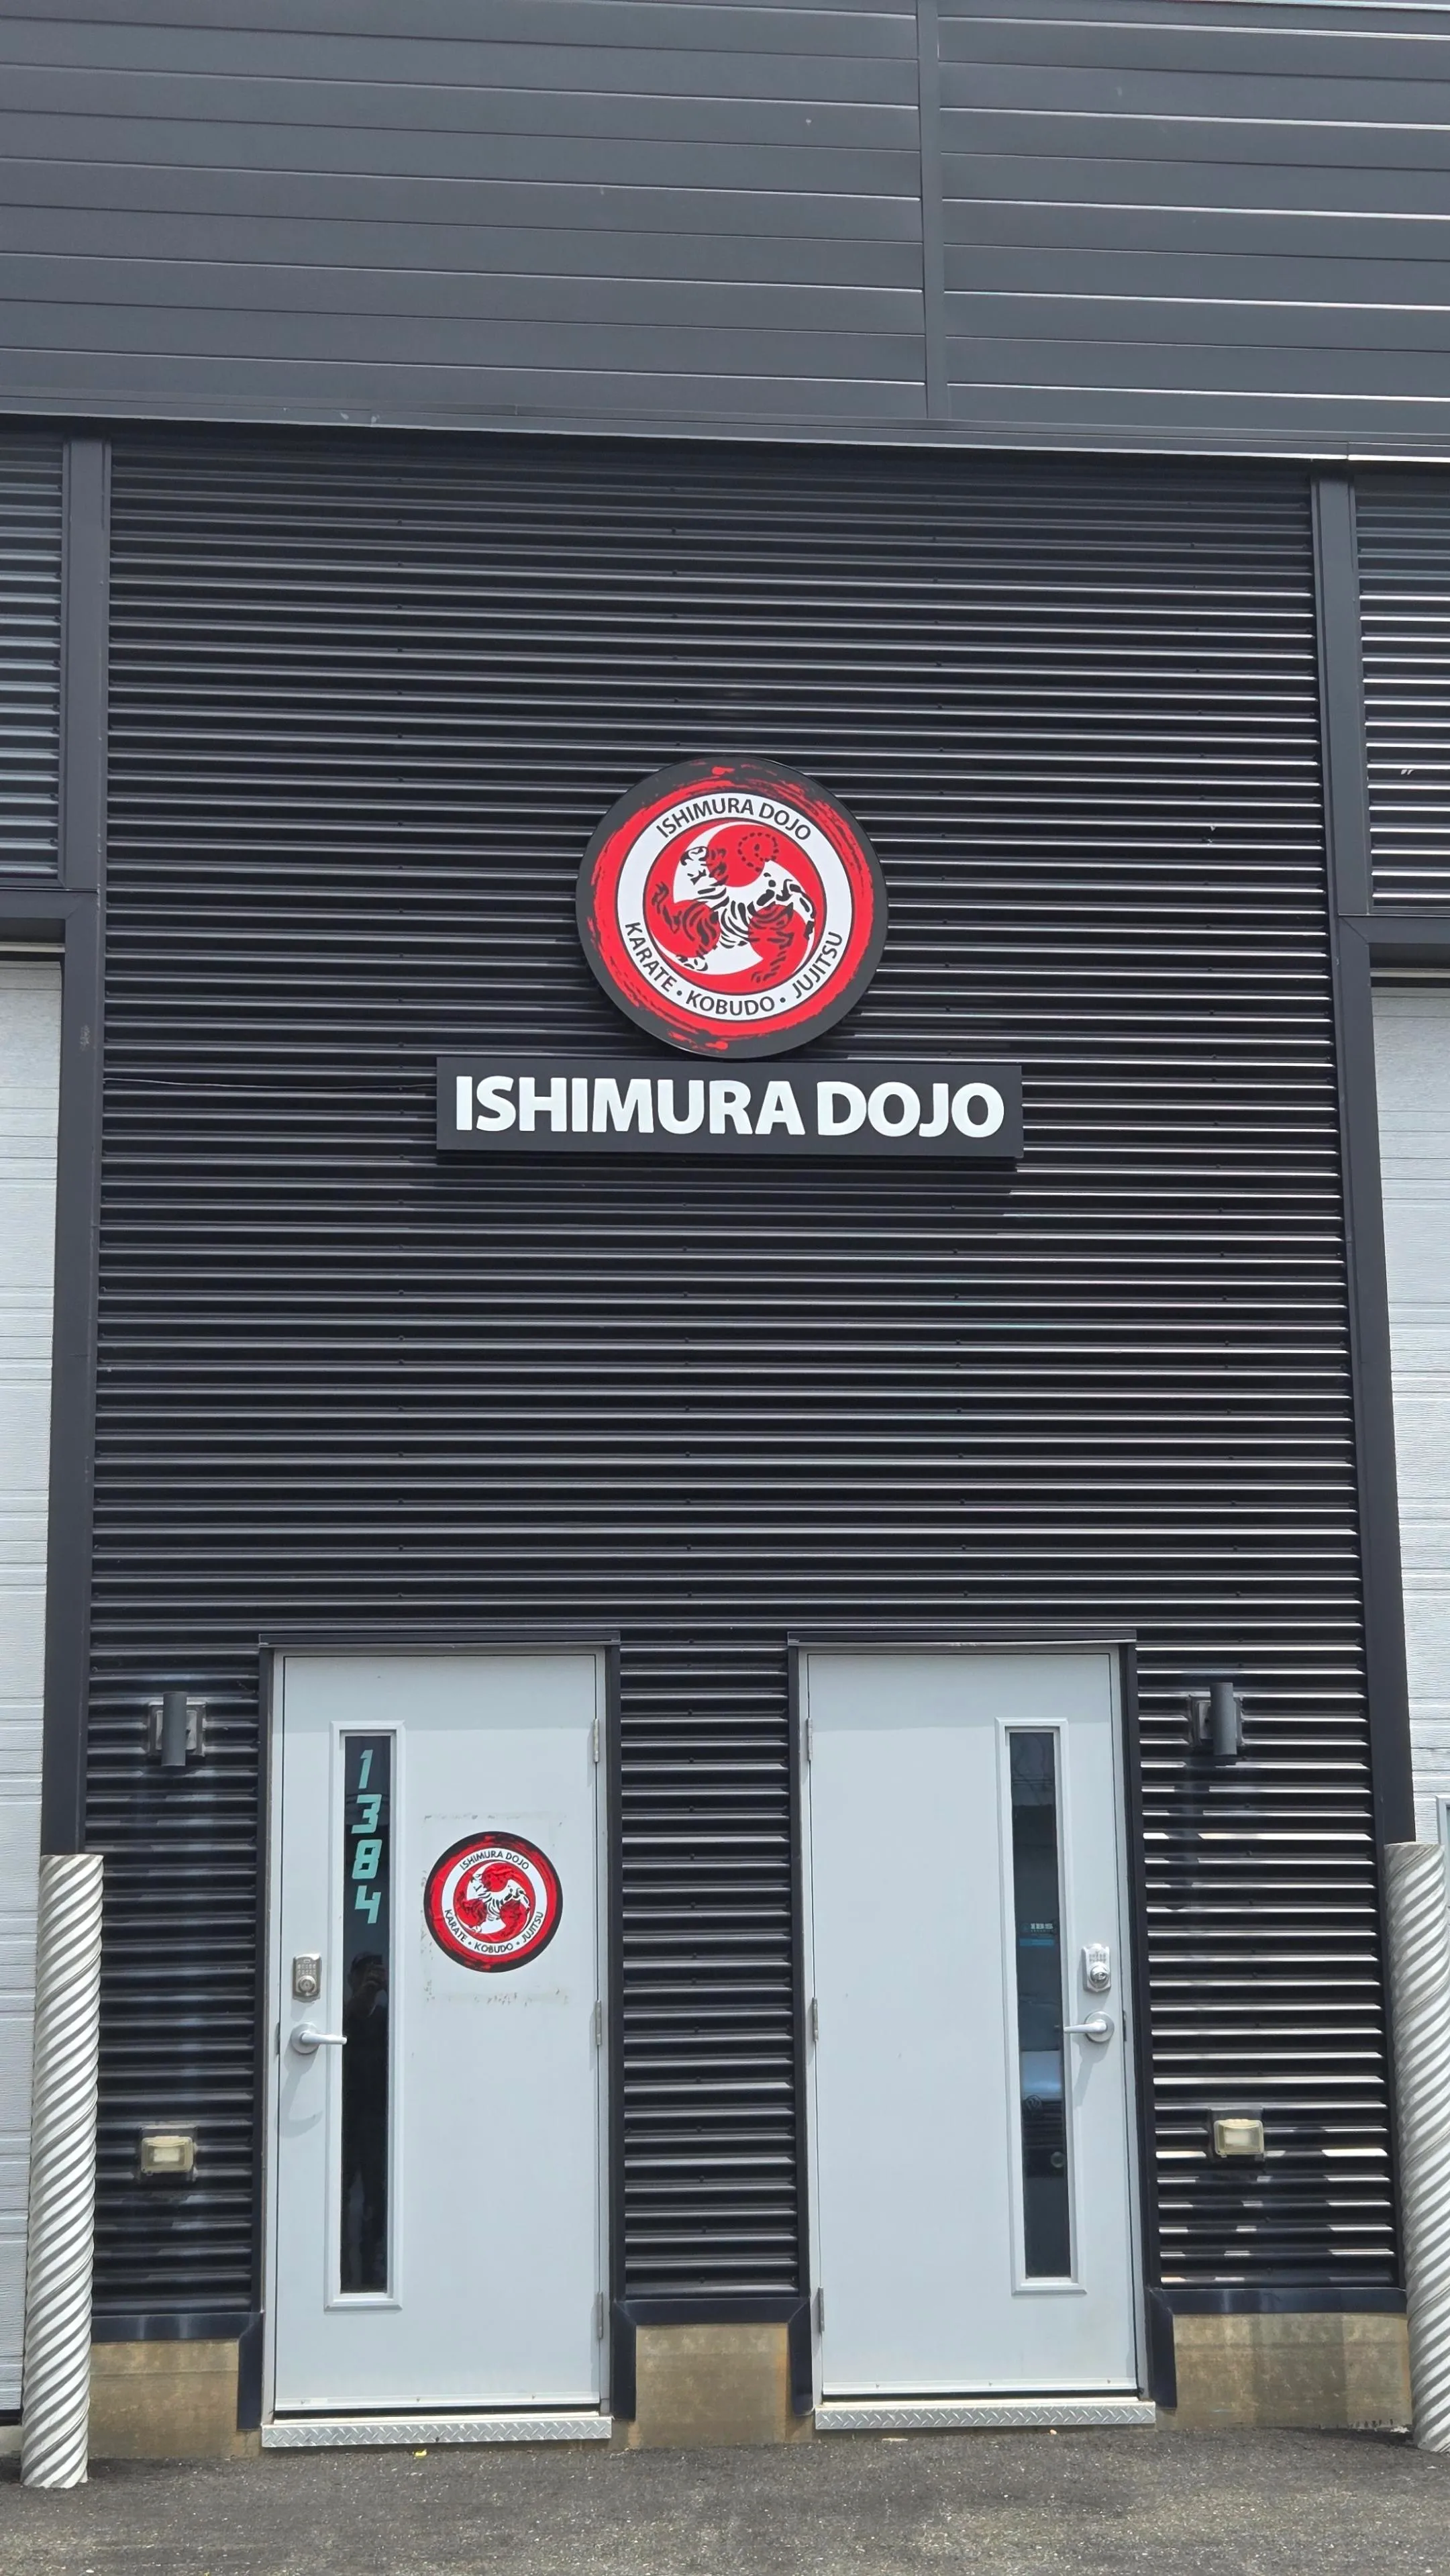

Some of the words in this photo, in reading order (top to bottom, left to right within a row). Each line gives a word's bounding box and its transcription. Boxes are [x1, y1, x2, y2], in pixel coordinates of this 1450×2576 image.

[656, 797, 754, 838] ISHIMURA
[758, 803, 811, 841] DOJO
[625, 921, 678, 993] KARATE
[685, 989, 775, 1016] KOBUDO
[791, 931, 843, 999] JUJITSU
[456, 1075, 806, 1135] ISHIMURA
[817, 1081, 1005, 1138] DOJO
[351, 1749, 382, 1924] 1384
[460, 1850, 503, 1871] ISHIMURA
[505, 1852, 529, 1870] DOJO
[444, 1909, 467, 1942] KARATE
[474, 1942, 513, 1953] KOBUDO
[522, 1911, 543, 1943] JUJITSU
